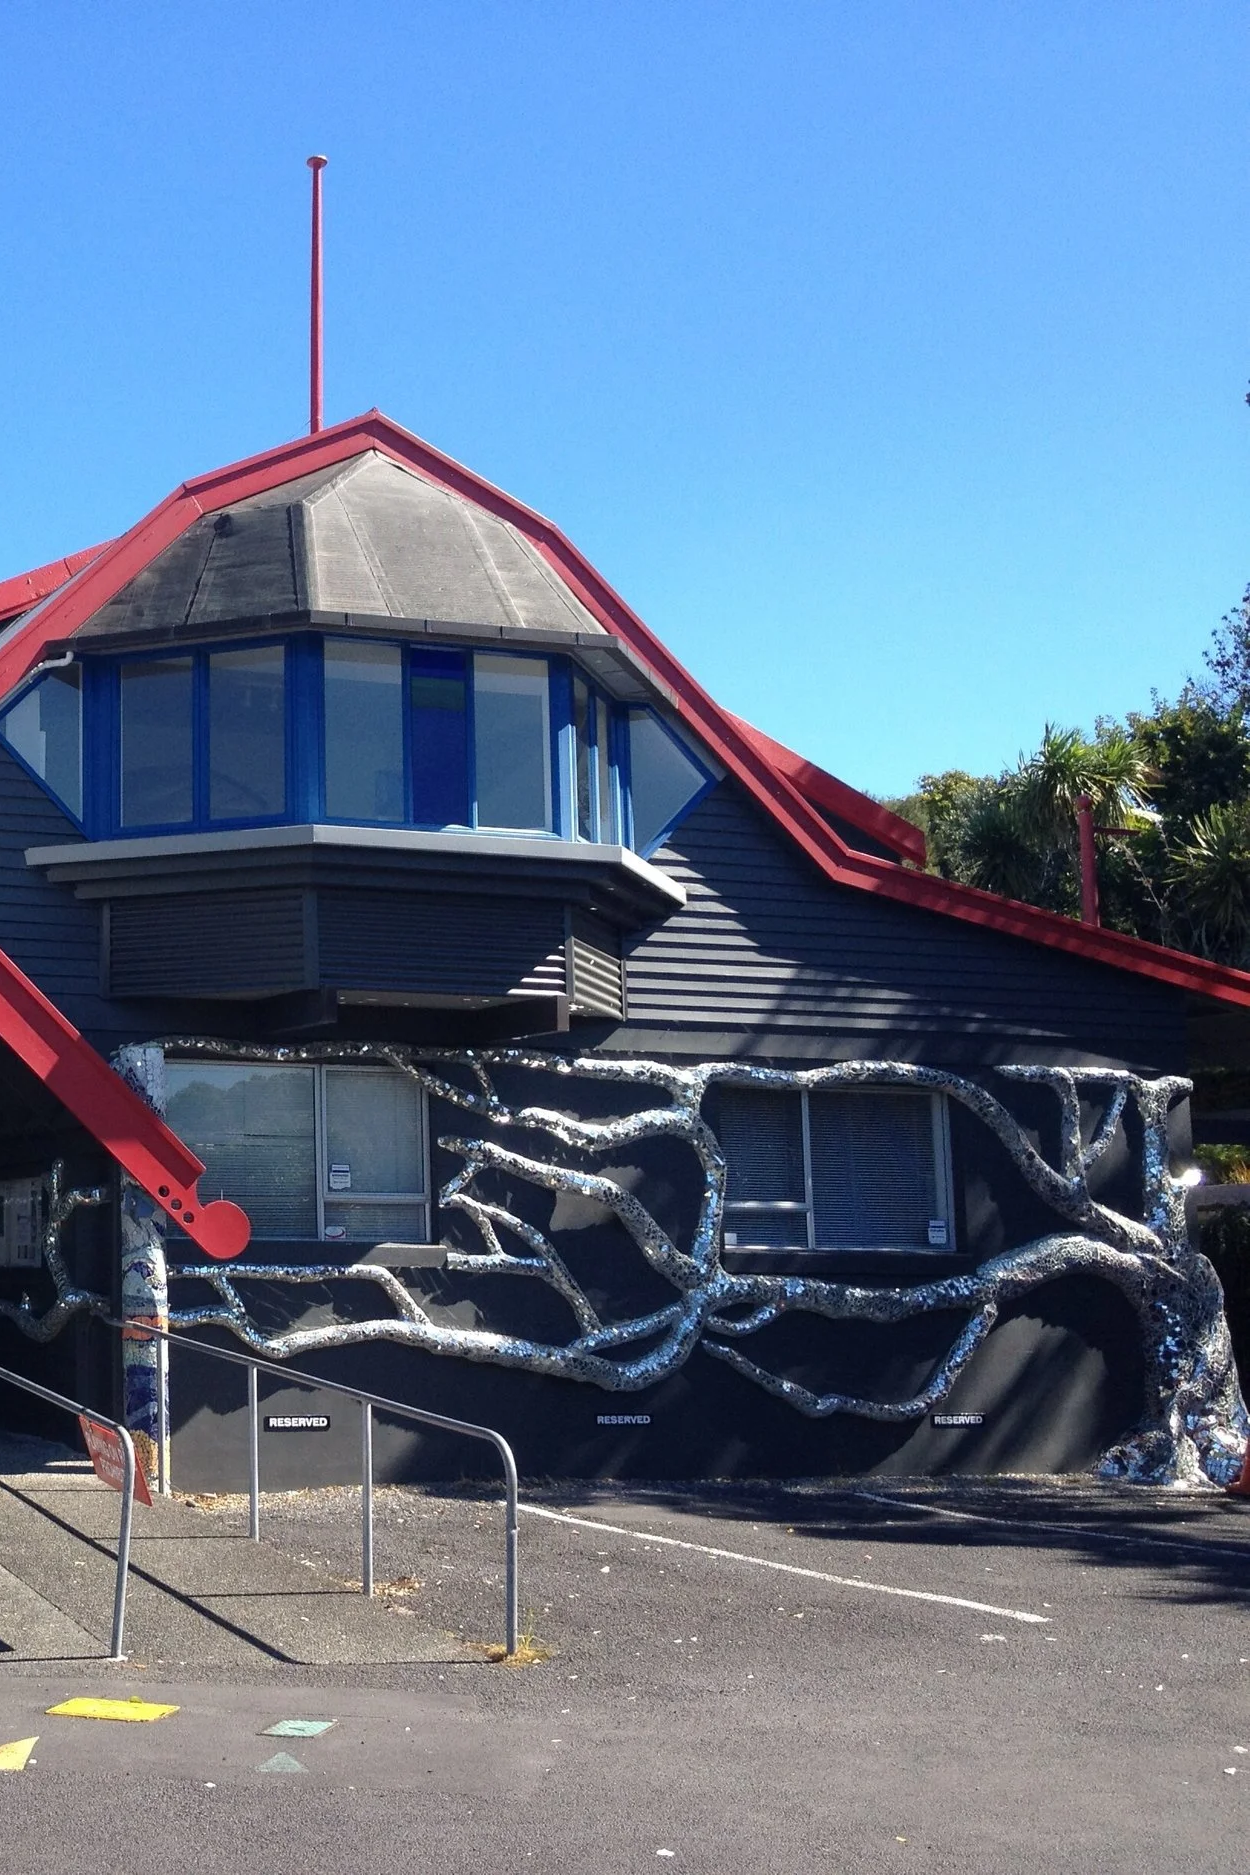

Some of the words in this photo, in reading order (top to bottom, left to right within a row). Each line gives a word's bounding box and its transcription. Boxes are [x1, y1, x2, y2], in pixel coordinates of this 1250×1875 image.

[269, 1417, 328, 1427] RESERVED
[596, 1415, 651, 1424] RESERVED
[934, 1415, 983, 1425] RESERVED
